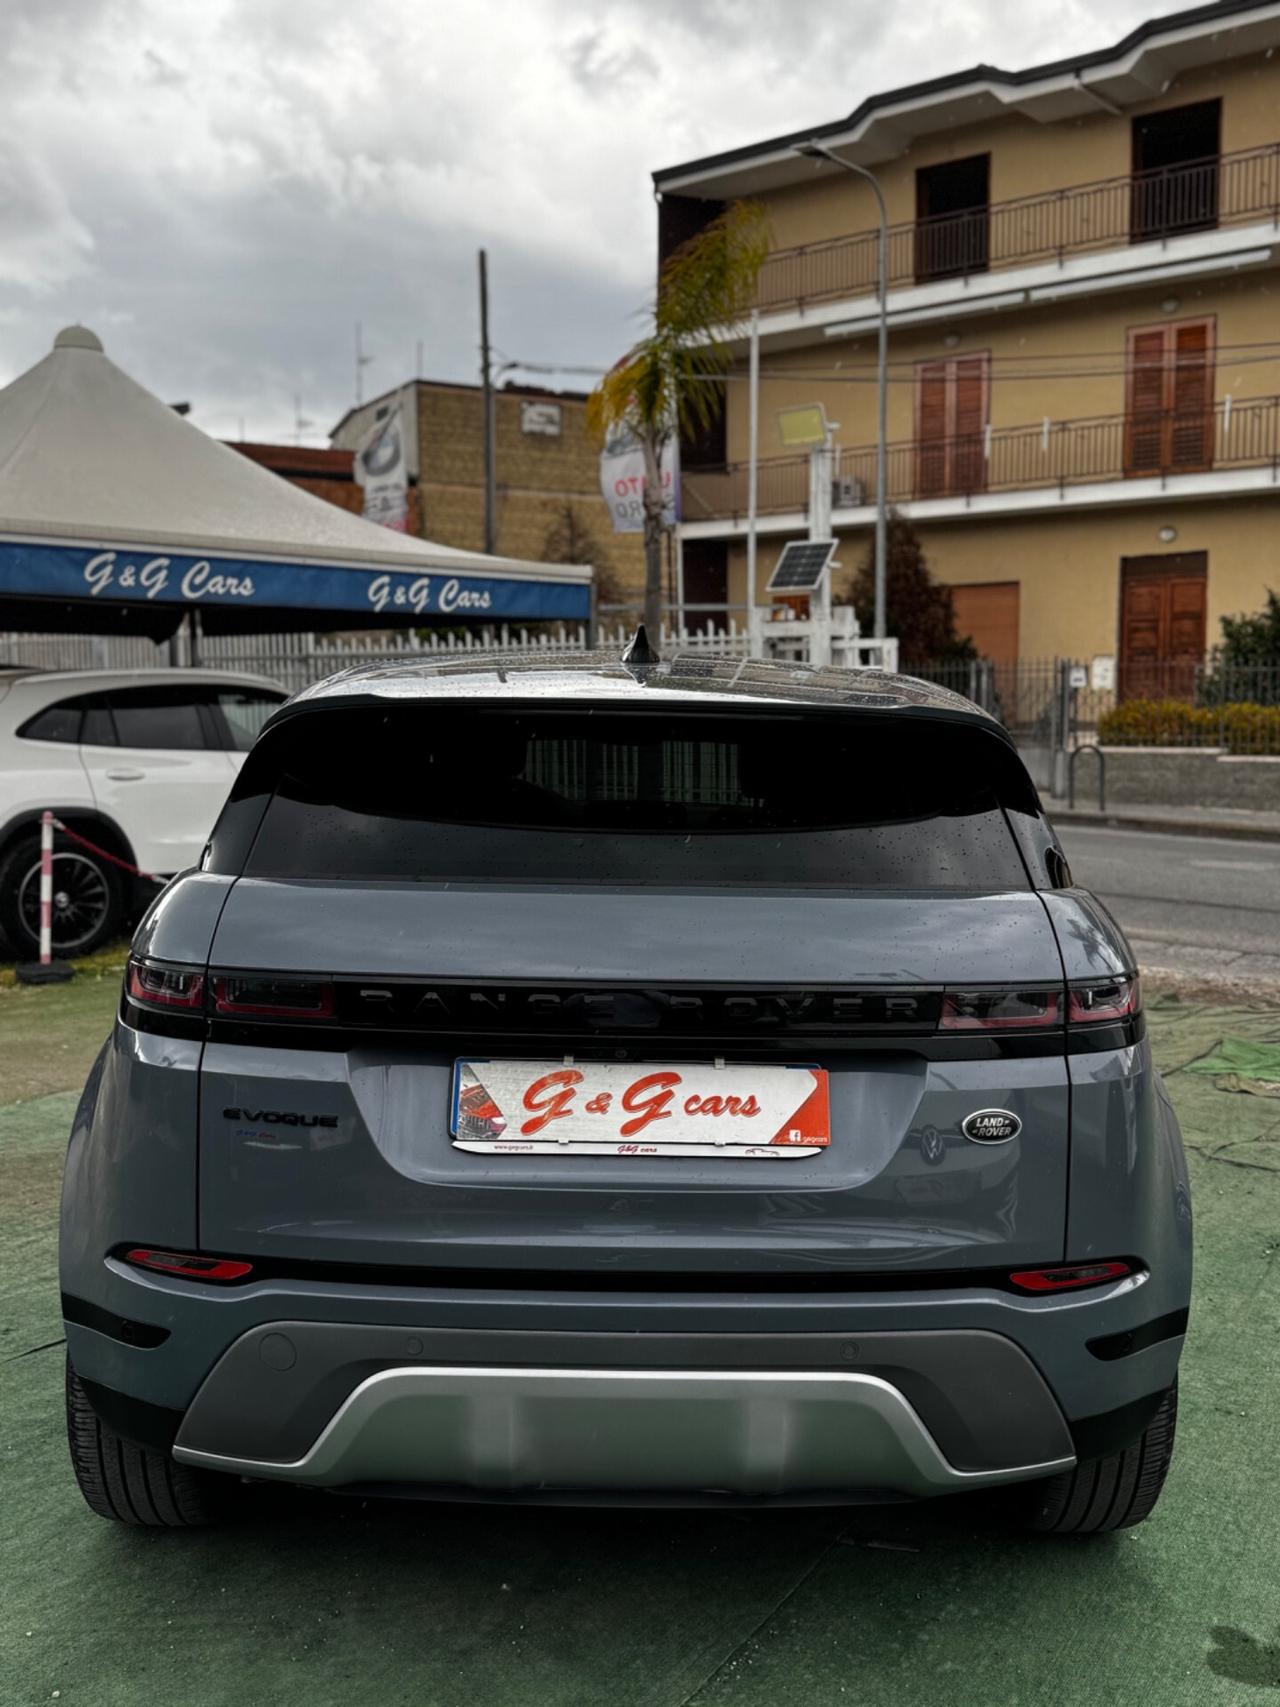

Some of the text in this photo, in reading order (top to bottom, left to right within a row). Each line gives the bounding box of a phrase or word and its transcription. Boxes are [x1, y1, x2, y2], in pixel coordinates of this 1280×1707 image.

[84, 552, 256, 599] G&G Cars
[367, 575, 492, 614] G&G Cars
[359, 989, 920, 1021] RANGE ROVER
[223, 1108, 339, 1128] EVOQUE
[683, 1094, 761, 1118] cars
[976, 1117, 1004, 1127] LAND
[978, 1127, 1012, 1137] ROVER
